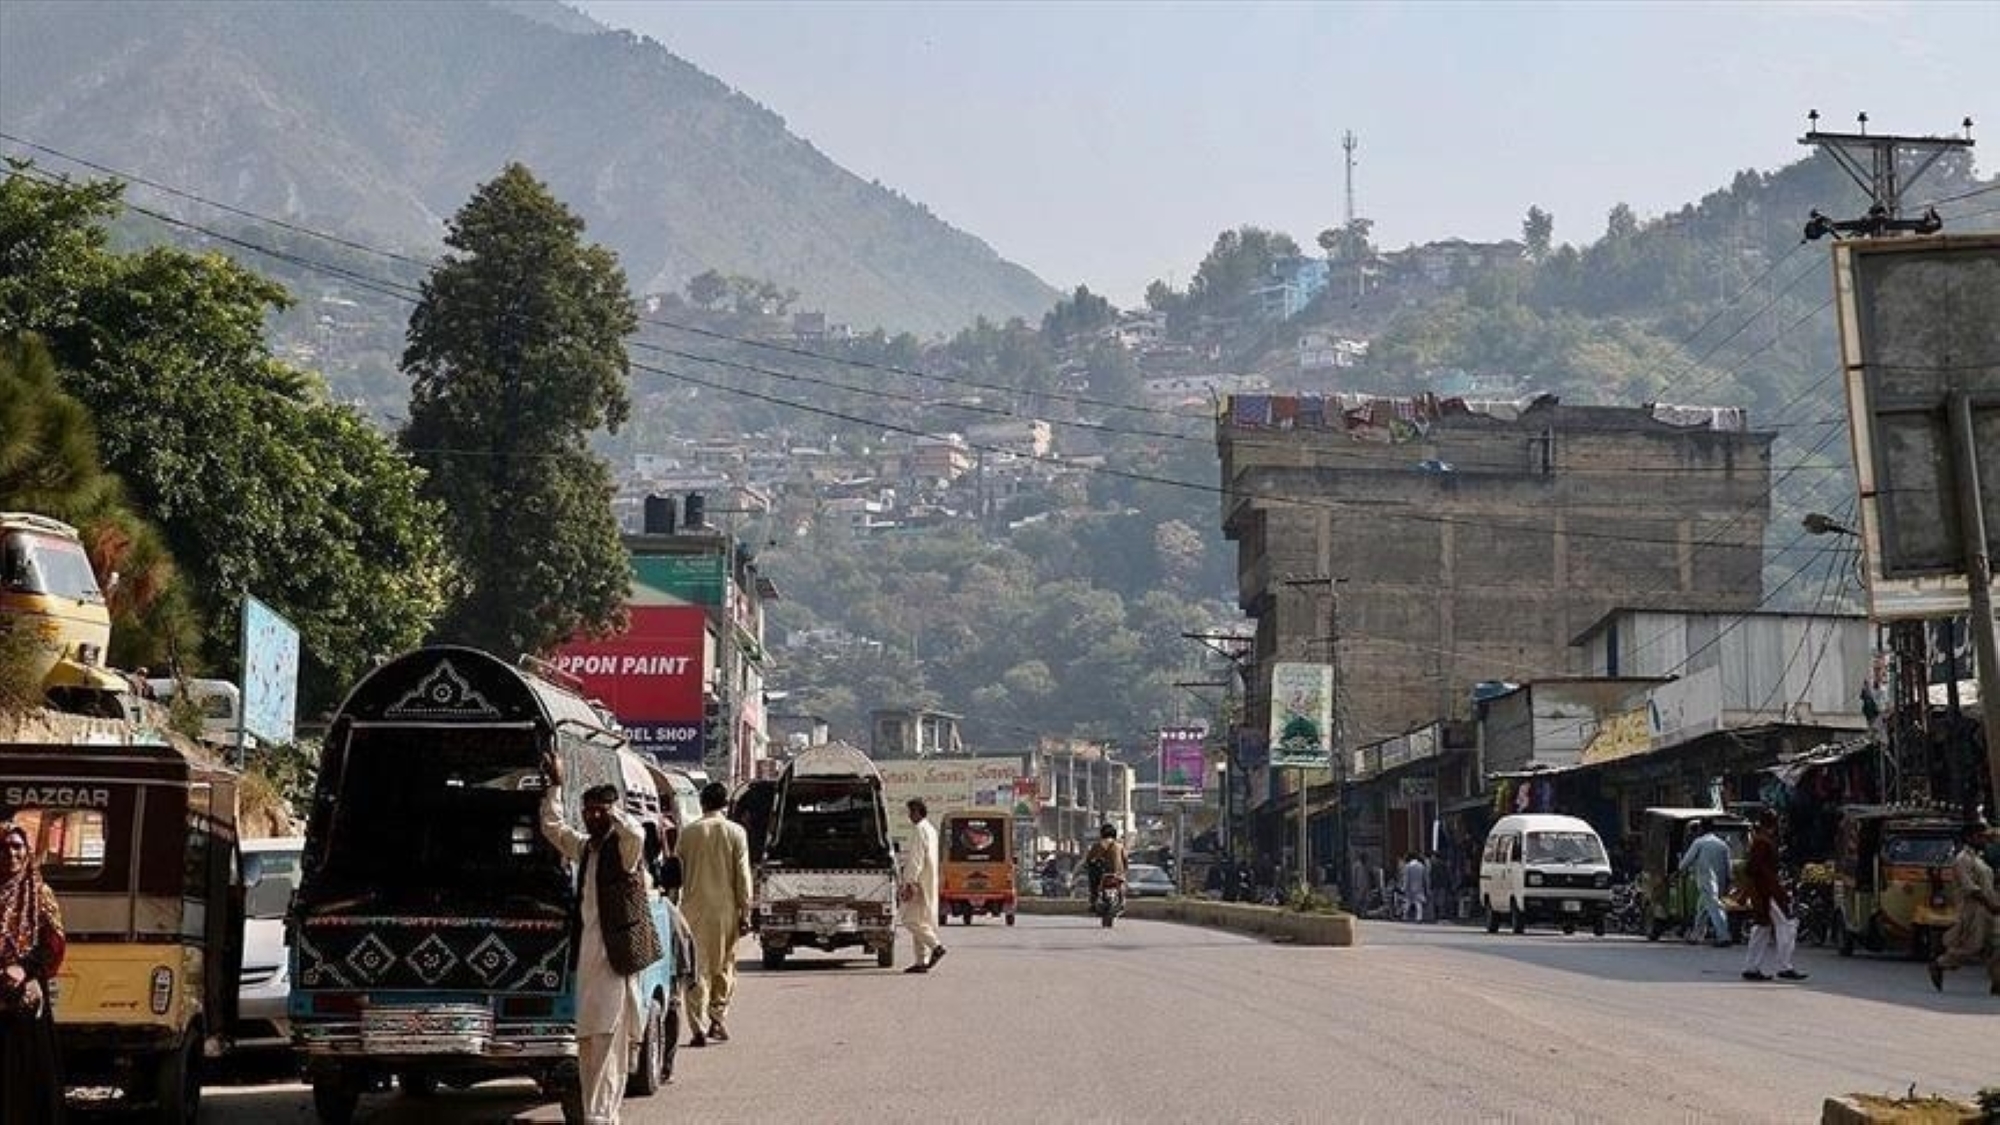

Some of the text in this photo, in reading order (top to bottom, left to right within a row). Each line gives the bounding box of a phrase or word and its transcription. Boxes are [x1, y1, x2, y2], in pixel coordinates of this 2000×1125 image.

[555, 655, 692, 675] PPON PAINT
[624, 727, 698, 742] DEL SHOP
[6, 787, 110, 807] SAZGAR
